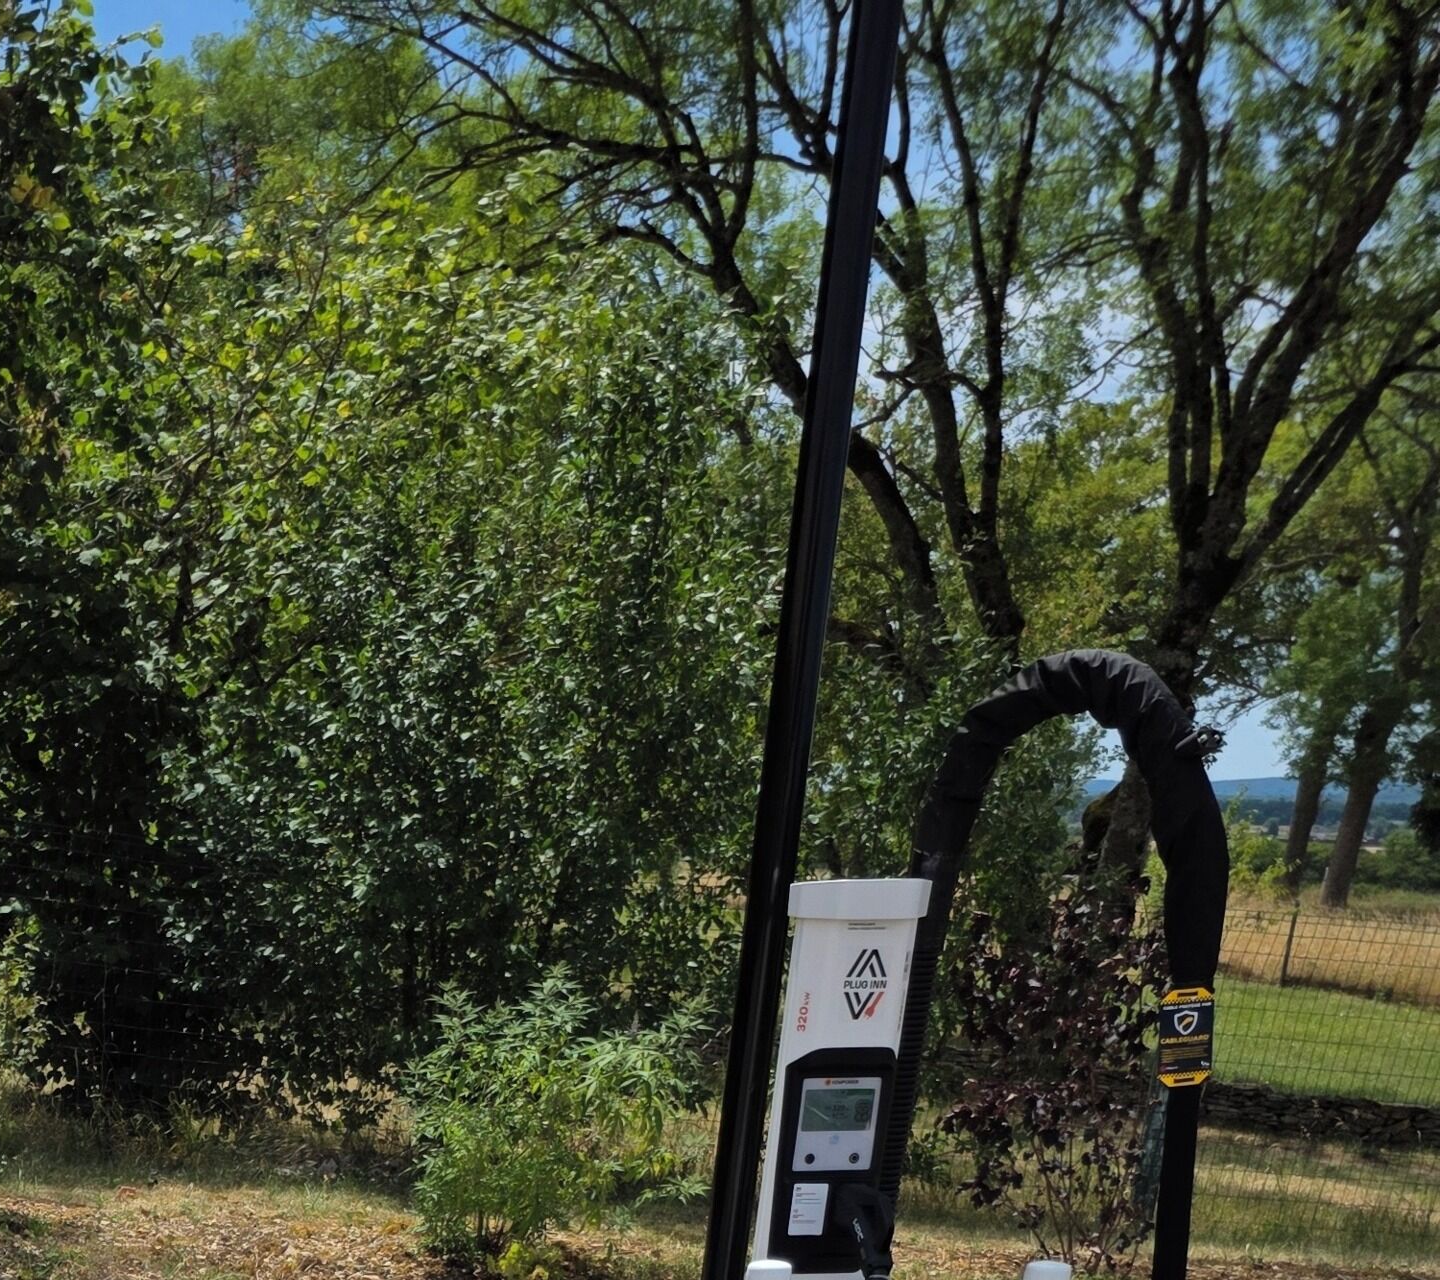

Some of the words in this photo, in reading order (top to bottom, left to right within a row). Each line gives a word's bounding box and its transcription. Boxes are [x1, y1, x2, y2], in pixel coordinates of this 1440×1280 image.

[843, 980, 869, 989] PLUG
[869, 980, 888, 989] INN
[1160, 1034, 1210, 1045] CABLEGUARD
